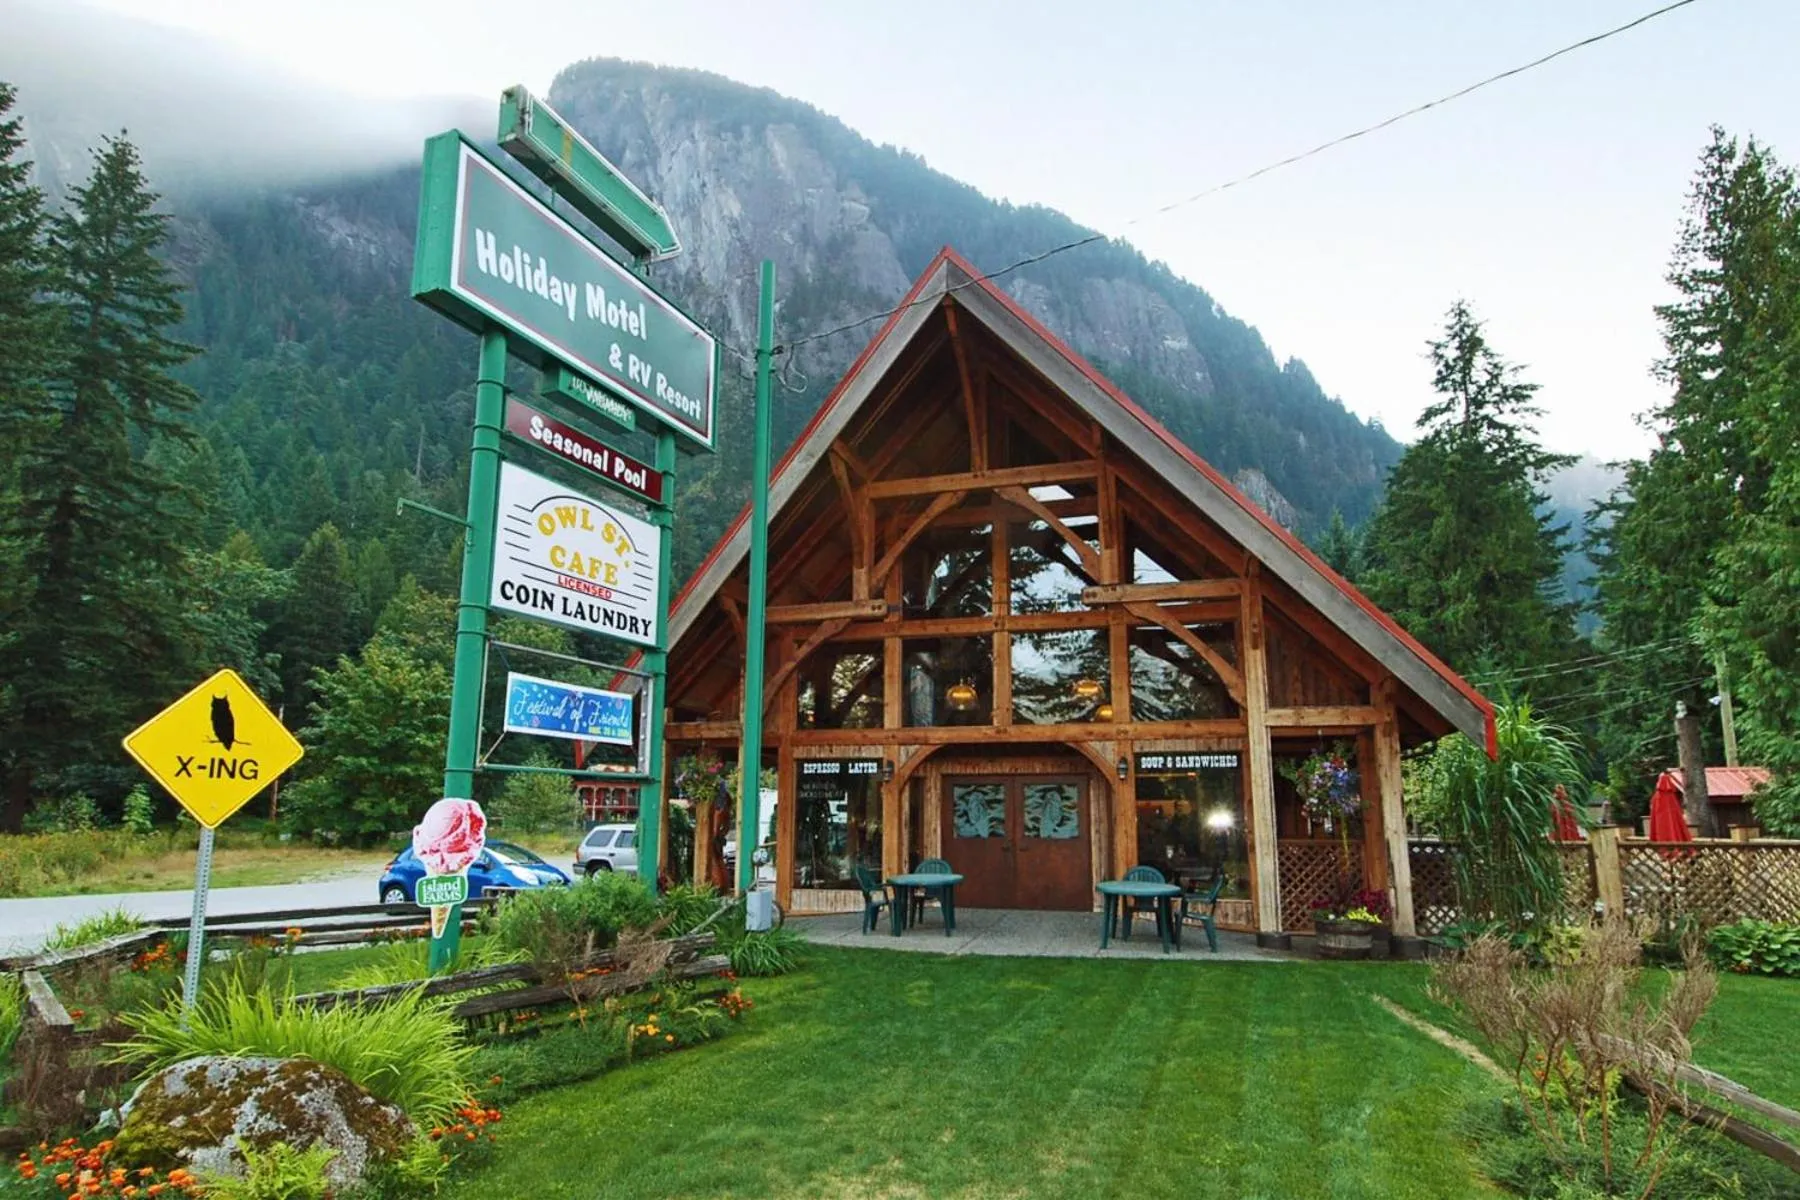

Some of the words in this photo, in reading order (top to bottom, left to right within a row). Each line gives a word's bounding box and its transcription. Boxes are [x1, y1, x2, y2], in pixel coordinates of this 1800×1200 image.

[475, 228, 577, 322] Holiday
[585, 282, 648, 341] Motel
[608, 343, 623, 372] &
[628, 353, 652, 388] RV
[656, 372, 702, 420] Resort
[529, 415, 608, 472] Seasonal
[614, 456, 646, 490] Pool
[537, 505, 594, 536] OWL
[549, 545, 619, 585] CAFE
[557, 575, 613, 600] LICENSED
[501, 580, 554, 612] COIN
[561, 596, 652, 637] LAUNDRY
[174, 755, 259, 780] X-ING
[804, 762, 840, 774] ESPRESSO
[848, 762, 878, 774] LATTES
[1141, 756, 1164, 768] SOUP
[1175, 755, 1237, 768] SANDWICHES
